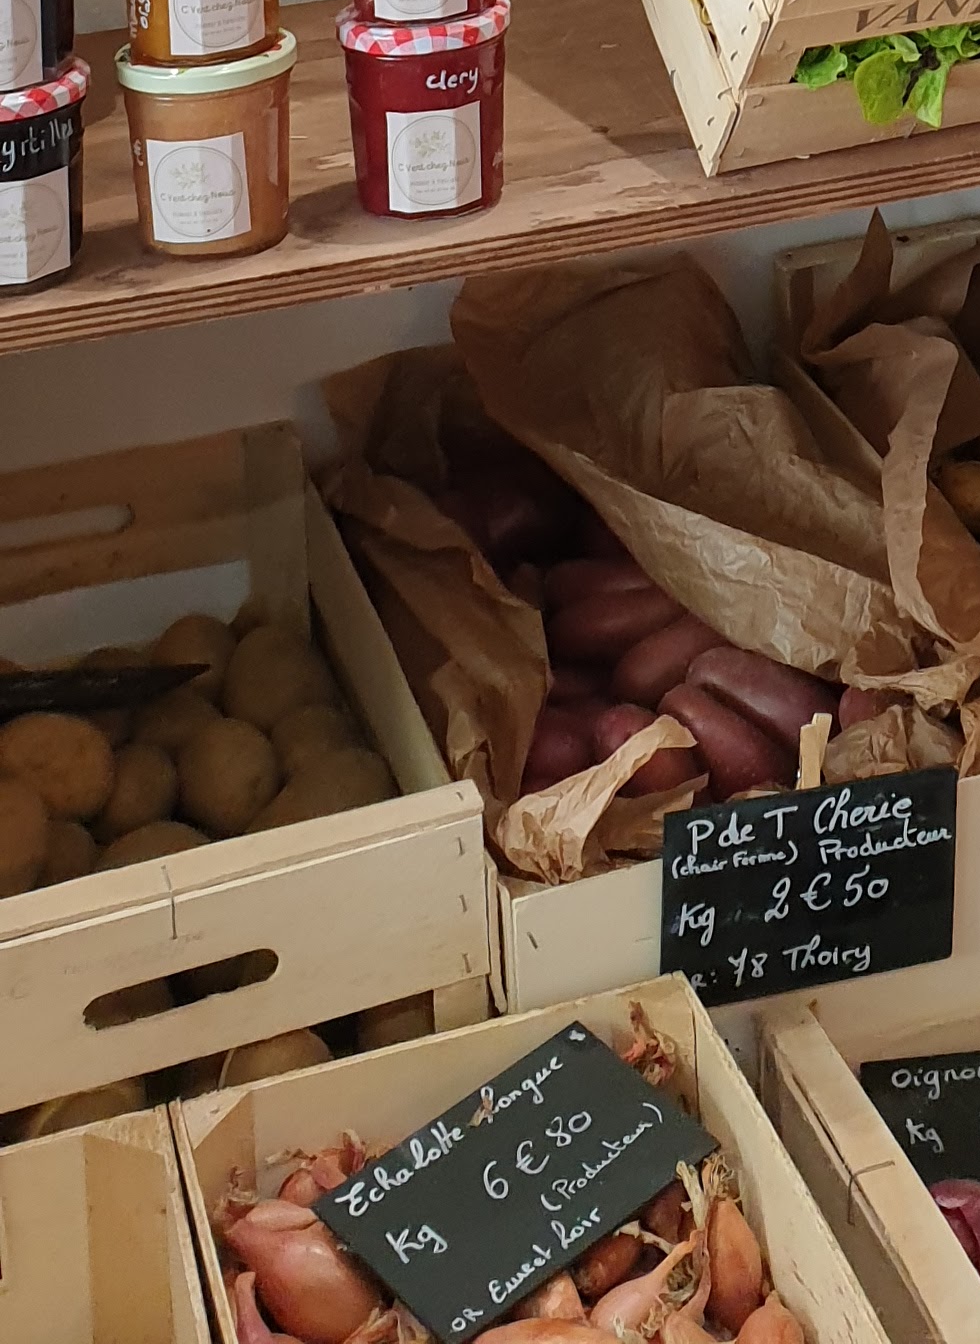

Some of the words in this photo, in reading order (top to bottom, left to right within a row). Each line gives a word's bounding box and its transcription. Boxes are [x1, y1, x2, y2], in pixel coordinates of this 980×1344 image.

[0, 117, 74, 173] yrtilles
[763, 805, 799, 840] T
[818, 820, 953, 865] Producteur
[782, 933, 872, 973] Thoiry
